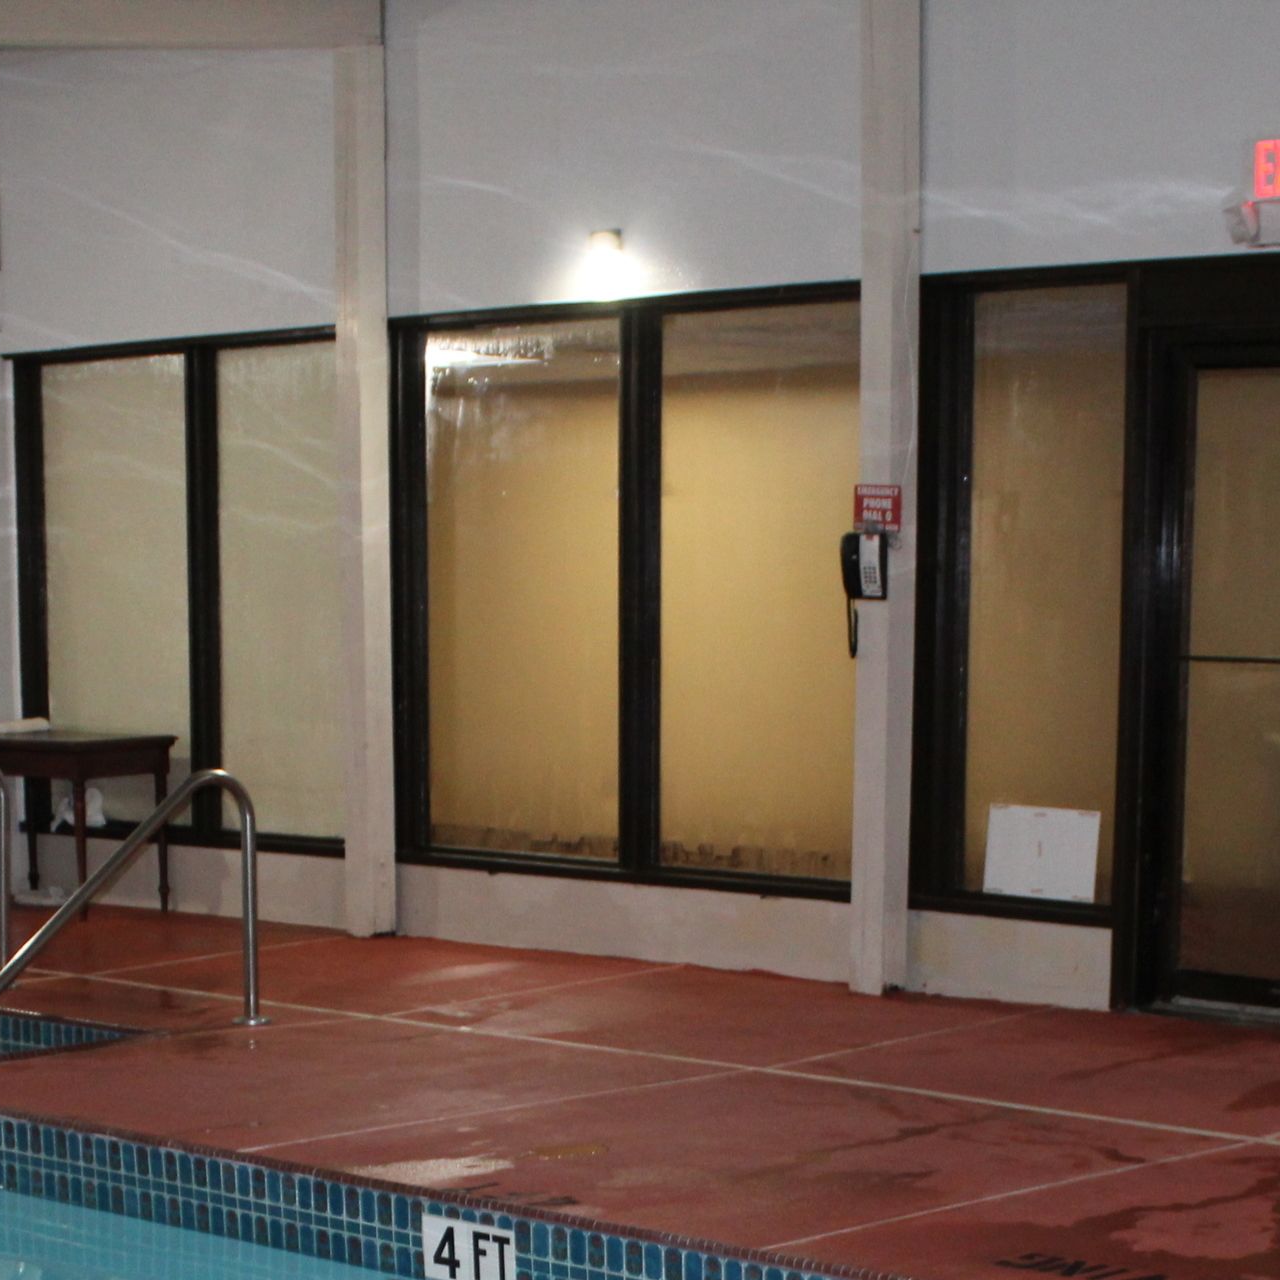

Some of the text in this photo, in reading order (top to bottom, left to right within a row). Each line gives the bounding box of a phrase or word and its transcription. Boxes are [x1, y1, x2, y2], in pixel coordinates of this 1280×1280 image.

[857, 486, 899, 496] EMERGENCY
[863, 498, 892, 509] PHONE
[863, 509, 882, 521] DIAL
[433, 1226, 461, 1280] 4
